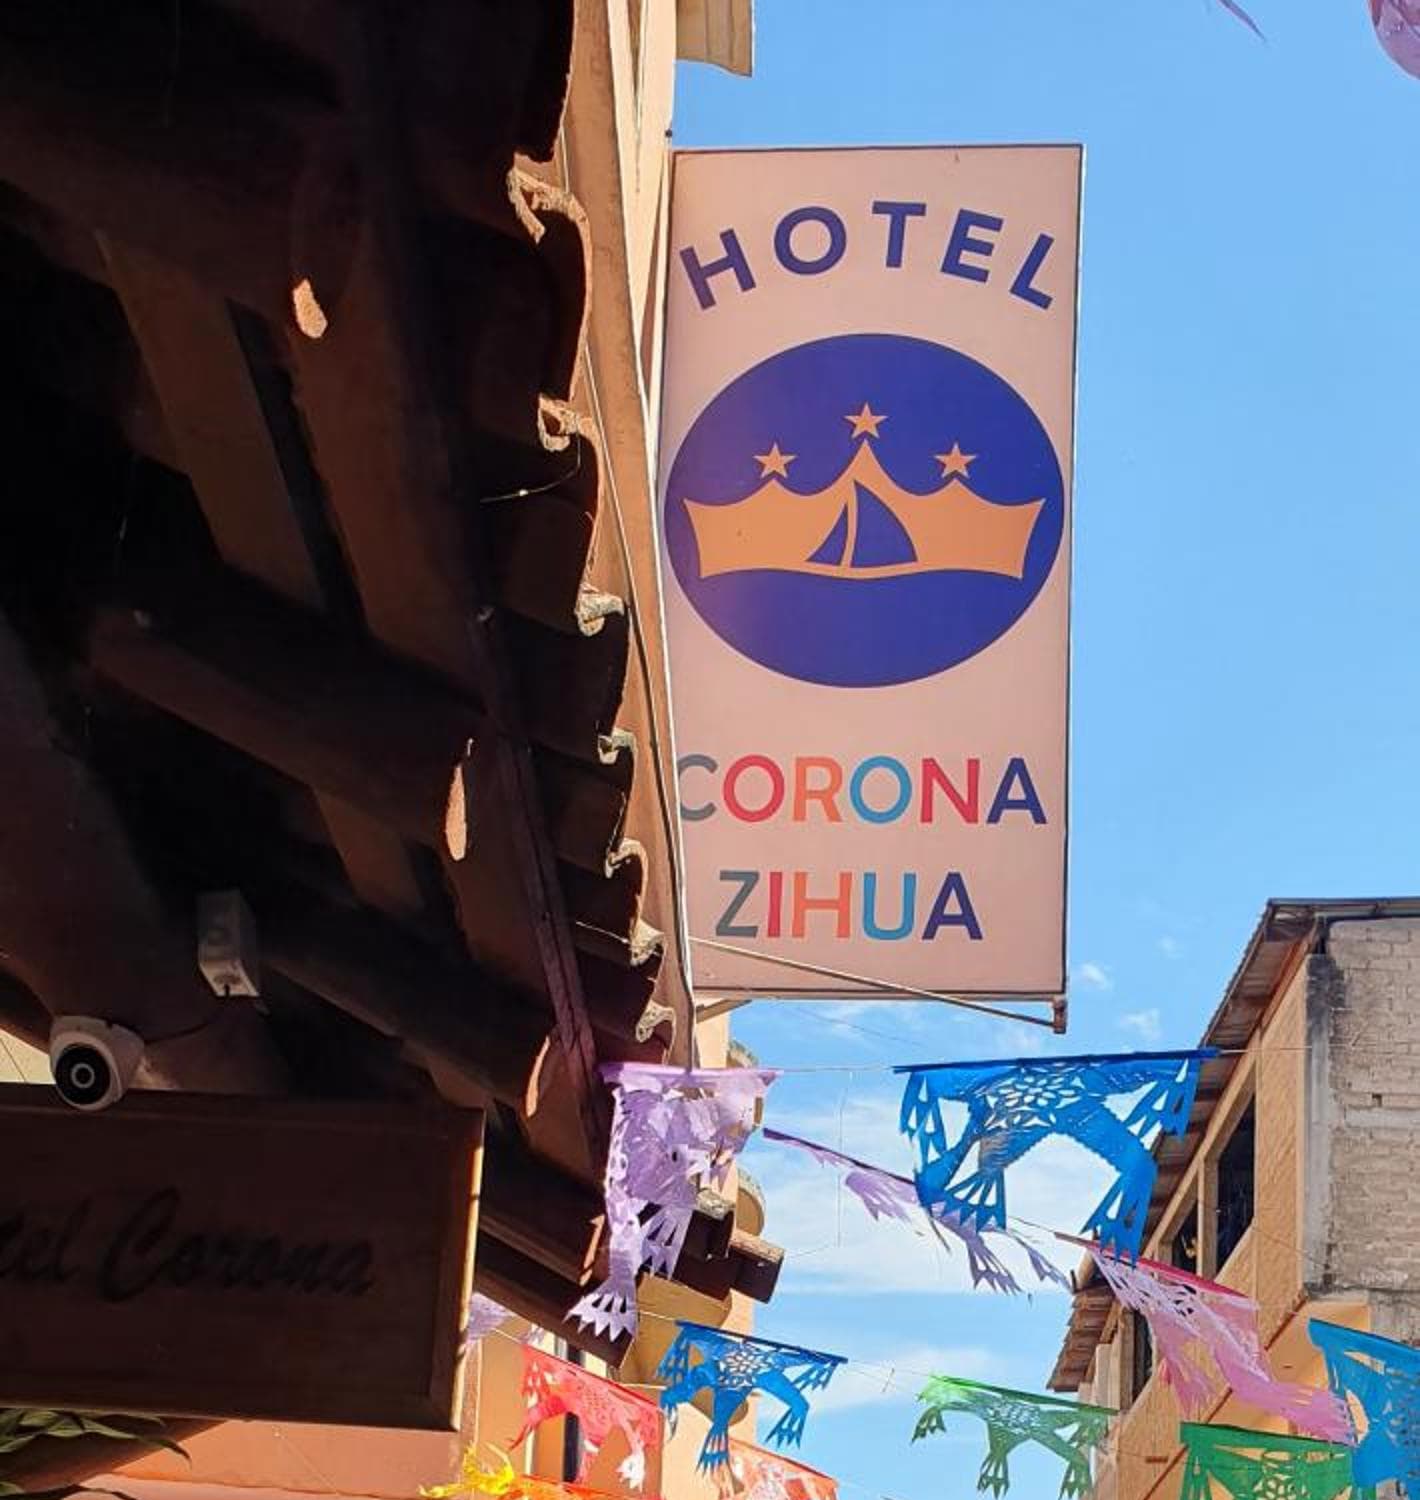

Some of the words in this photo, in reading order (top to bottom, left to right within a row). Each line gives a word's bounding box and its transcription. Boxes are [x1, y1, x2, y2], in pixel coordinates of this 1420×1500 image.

[680, 201, 1054, 310] HOTEL
[677, 754, 1046, 824] CORONA
[715, 870, 982, 941] ZIHUA
[101, 1185, 374, 1302] Corona
